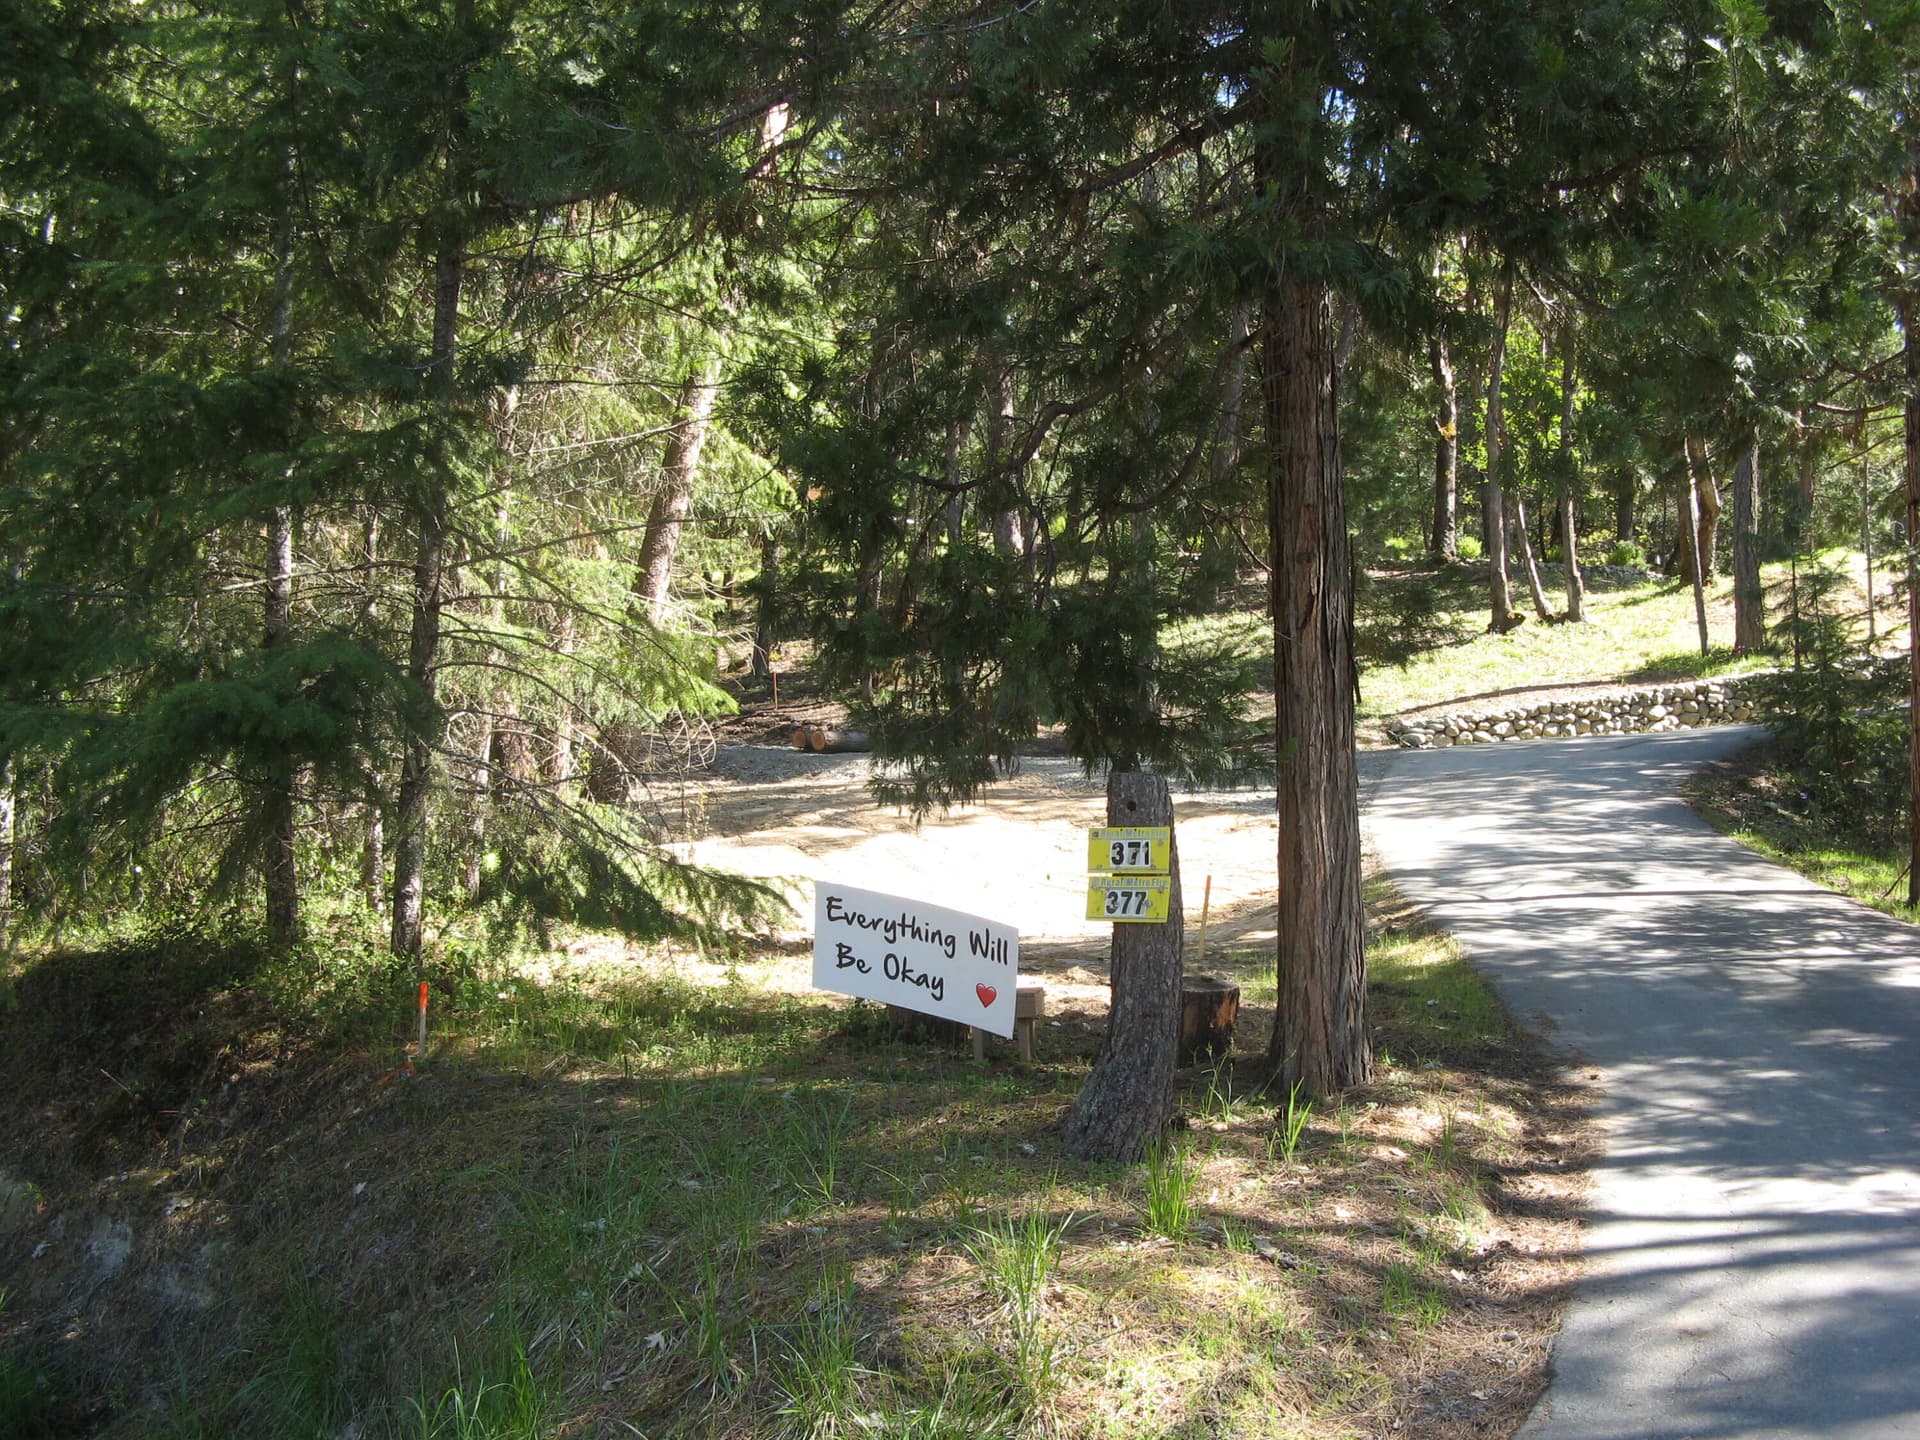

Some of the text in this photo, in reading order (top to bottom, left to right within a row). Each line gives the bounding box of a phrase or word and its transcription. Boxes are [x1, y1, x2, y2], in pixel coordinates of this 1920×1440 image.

[1111, 841, 1150, 866] 371
[1106, 891, 1147, 915] 377
[826, 896, 1008, 965] Everything Will
[836, 942, 945, 1001] Be Okay
